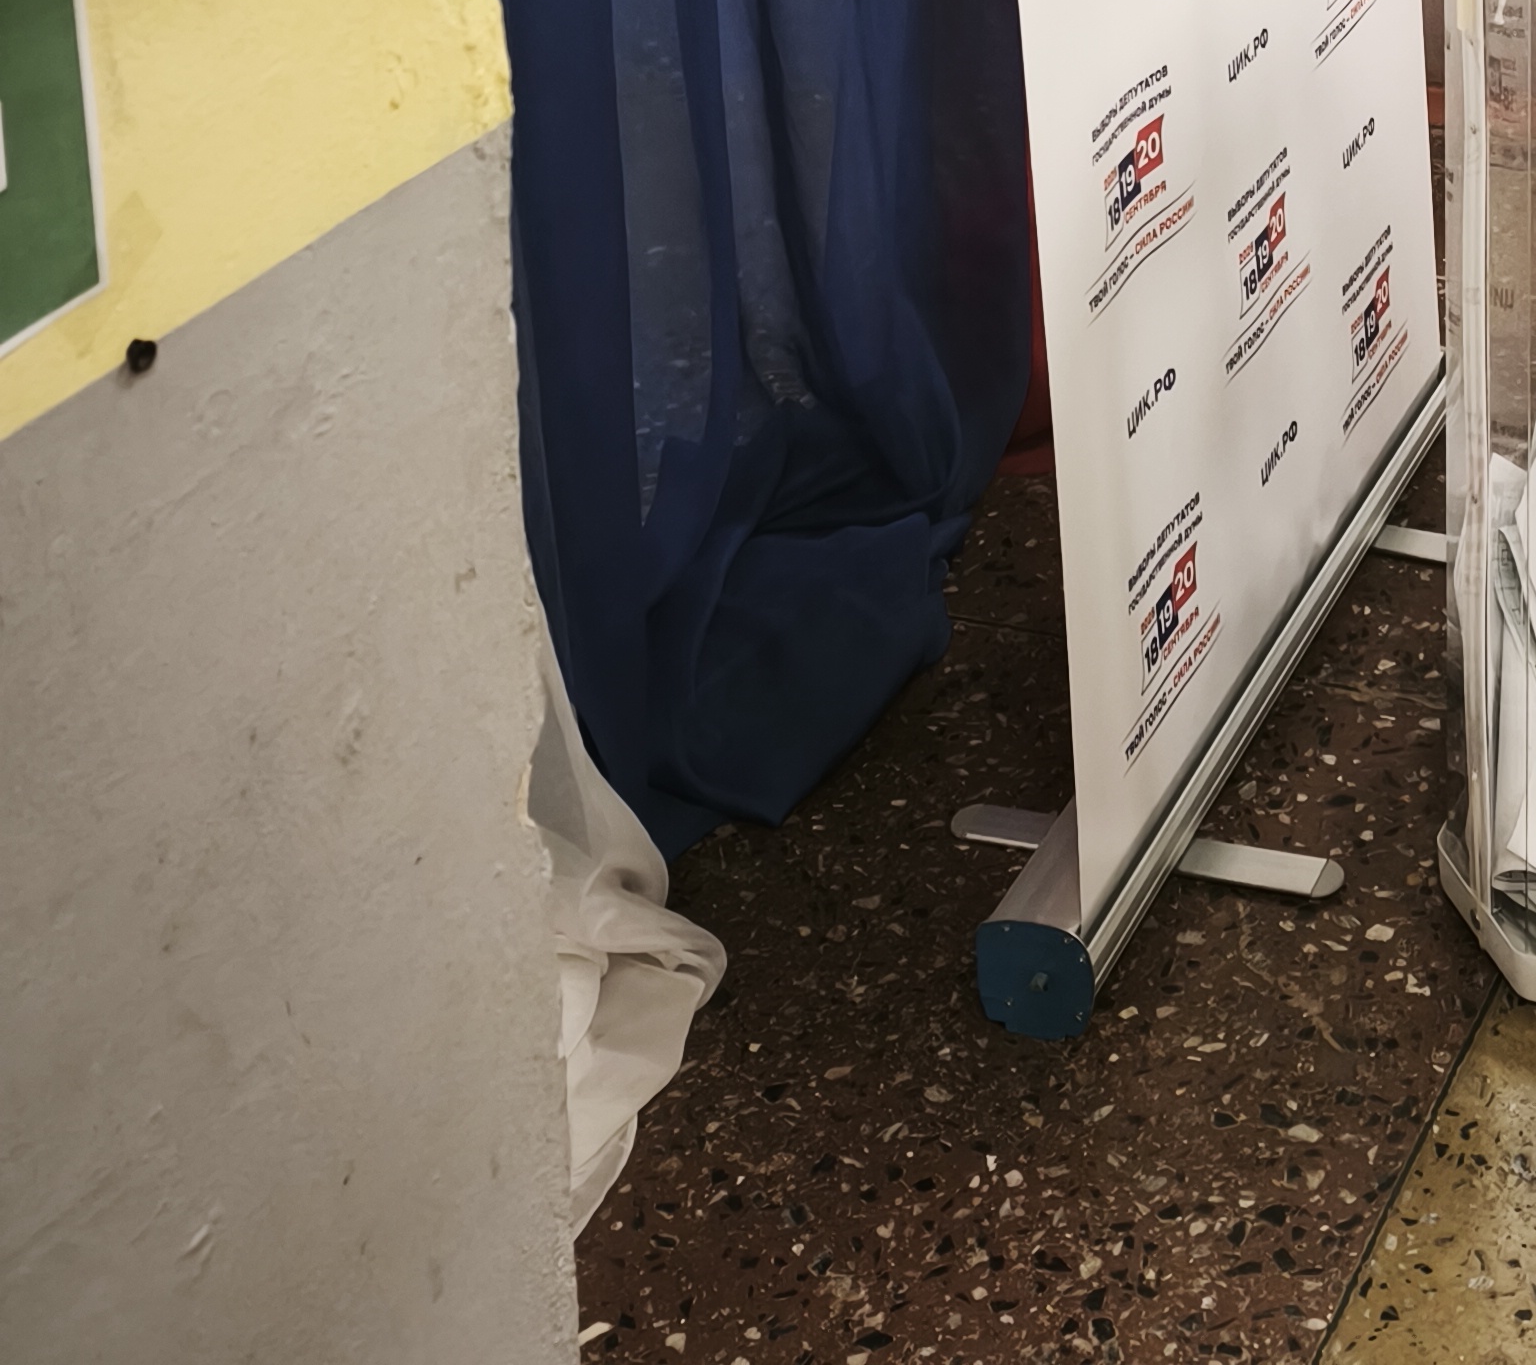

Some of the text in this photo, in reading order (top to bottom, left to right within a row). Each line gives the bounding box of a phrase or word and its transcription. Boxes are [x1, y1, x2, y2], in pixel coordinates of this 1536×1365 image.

[1227, 28, 1270, 83] ЦИК.РФ
[1091, 65, 1168, 143] ВЫБОРЫ ДЕПУТАТОВ
[1148, 85, 1172, 110] ДУМЫ
[1108, 131, 1160, 231] 18 19 20
[1341, 117, 1376, 170] ЦИК.РФ
[1124, 180, 1167, 224] СЕНТЯБРЯ
[1088, 280, 1109, 312] ТВОЙ
[1109, 255, 1128, 290] ГОЛОС
[1134, 228, 1158, 256] СИЛА
[1243, 207, 1284, 301] 18 19 20
[1354, 338, 1366, 366] 18
[1366, 310, 1376, 338] 19
[1376, 280, 1388, 313] 20
[1125, 368, 1177, 439] ЦИК.РФ
[1260, 419, 1298, 487] ЦИК.РФ
[1128, 491, 1200, 592] ВЫБОРЫ ДЕПУТАТОВ
[1145, 560, 1194, 673] 18 19 20
[1163, 605, 1200, 661] СЕНТЯБРЯ
[1125, 724, 1144, 761] ТВОЙ
[1145, 692, 1167, 732] ГОЛОС
[1173, 657, 1193, 688] СИЛА
